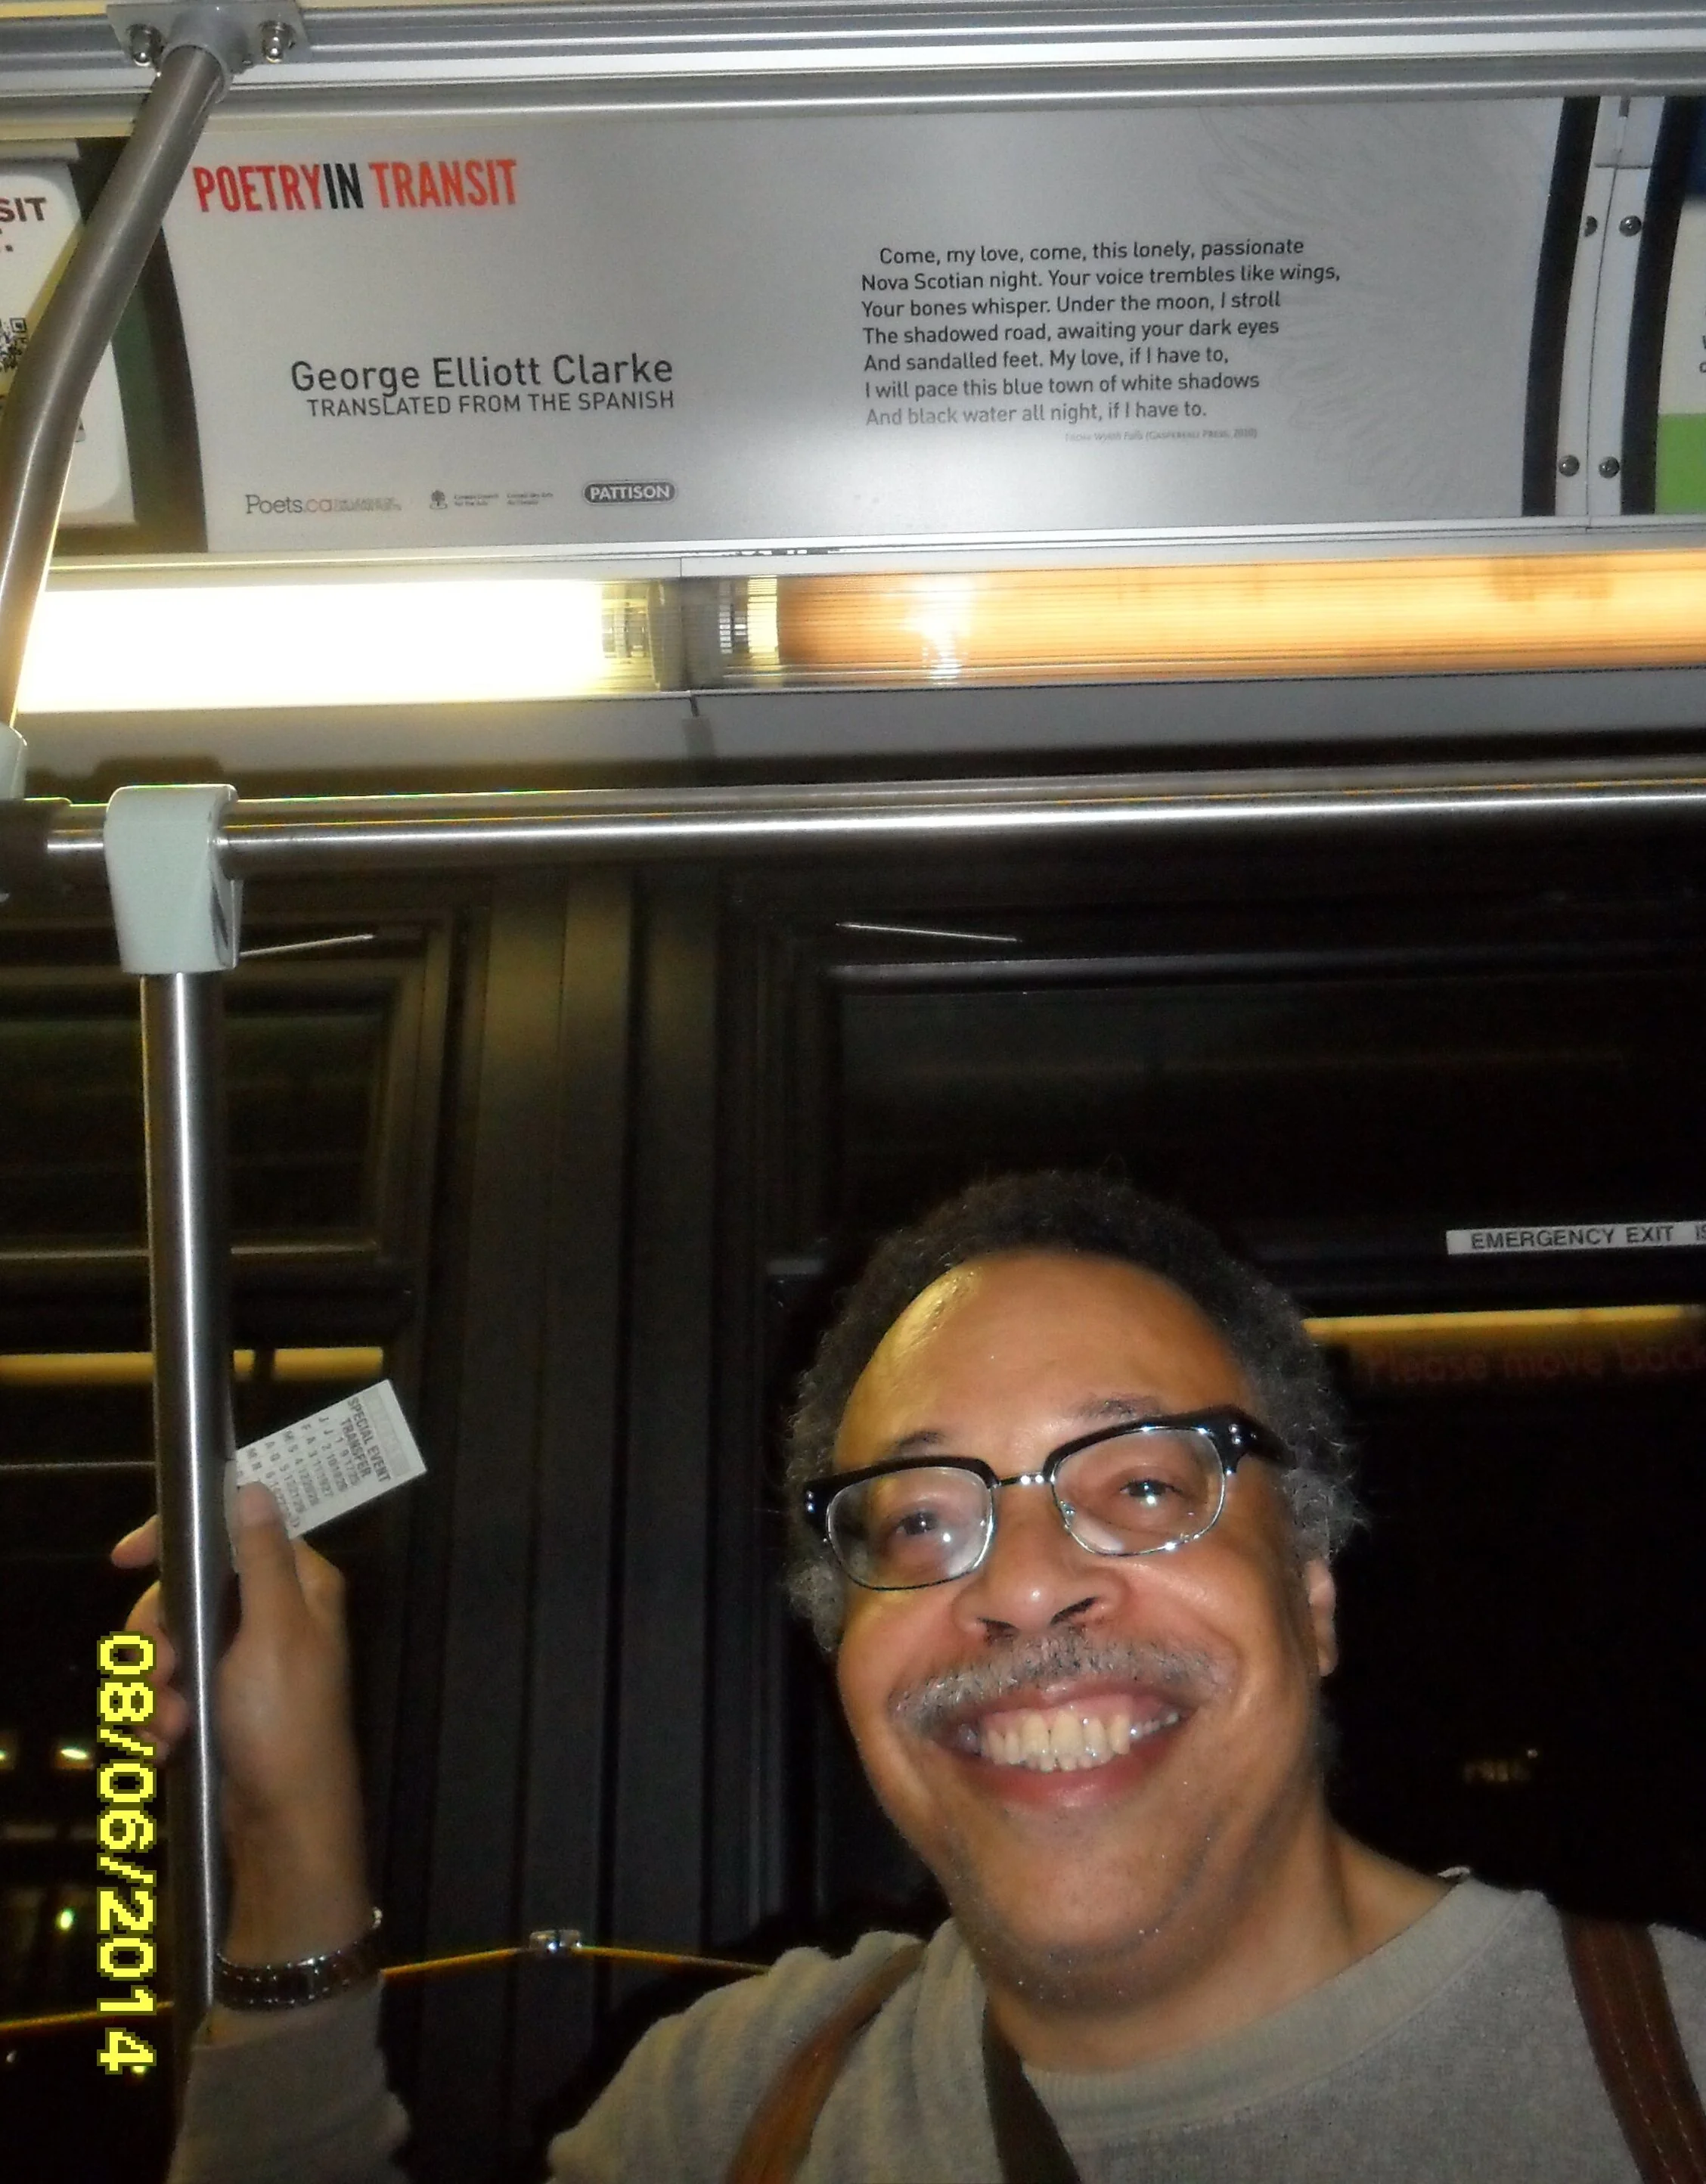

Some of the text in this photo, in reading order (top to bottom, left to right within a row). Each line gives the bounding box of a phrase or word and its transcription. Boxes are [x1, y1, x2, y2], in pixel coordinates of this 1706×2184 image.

[368, 158, 517, 209] TRANSIT
[879, 238, 1304, 266] Come, my love, come, this lonely, passionate
[861, 264, 1340, 292] Nova Scotian night. Your voice trembles like wings,
[861, 290, 1280, 318] Your bones whisper. Under the moon, I stroll
[862, 318, 1280, 344] The shadowed road, awaiting your dark eyes
[864, 346, 1229, 371] And sandalled feet. My love, if I have to,
[291, 352, 673, 397] George Elliott Clarke
[864, 372, 1260, 402] I will pace this blue town of white shadows
[307, 390, 675, 417] TRANSLATED FROM THE SPANISH
[866, 401, 1206, 426] And black water all night, if I have to.
[244, 494, 333, 514] Poets.ca
[590, 484, 670, 501] PATTISON
[1471, 1227, 1615, 1250] EMERGENCY
[1625, 1225, 1673, 1244] EXIT
[339, 1416, 373, 1478] TRANSFER
[346, 1396, 375, 1444] SPECIAL
[367, 1444, 391, 1484] EVENT
